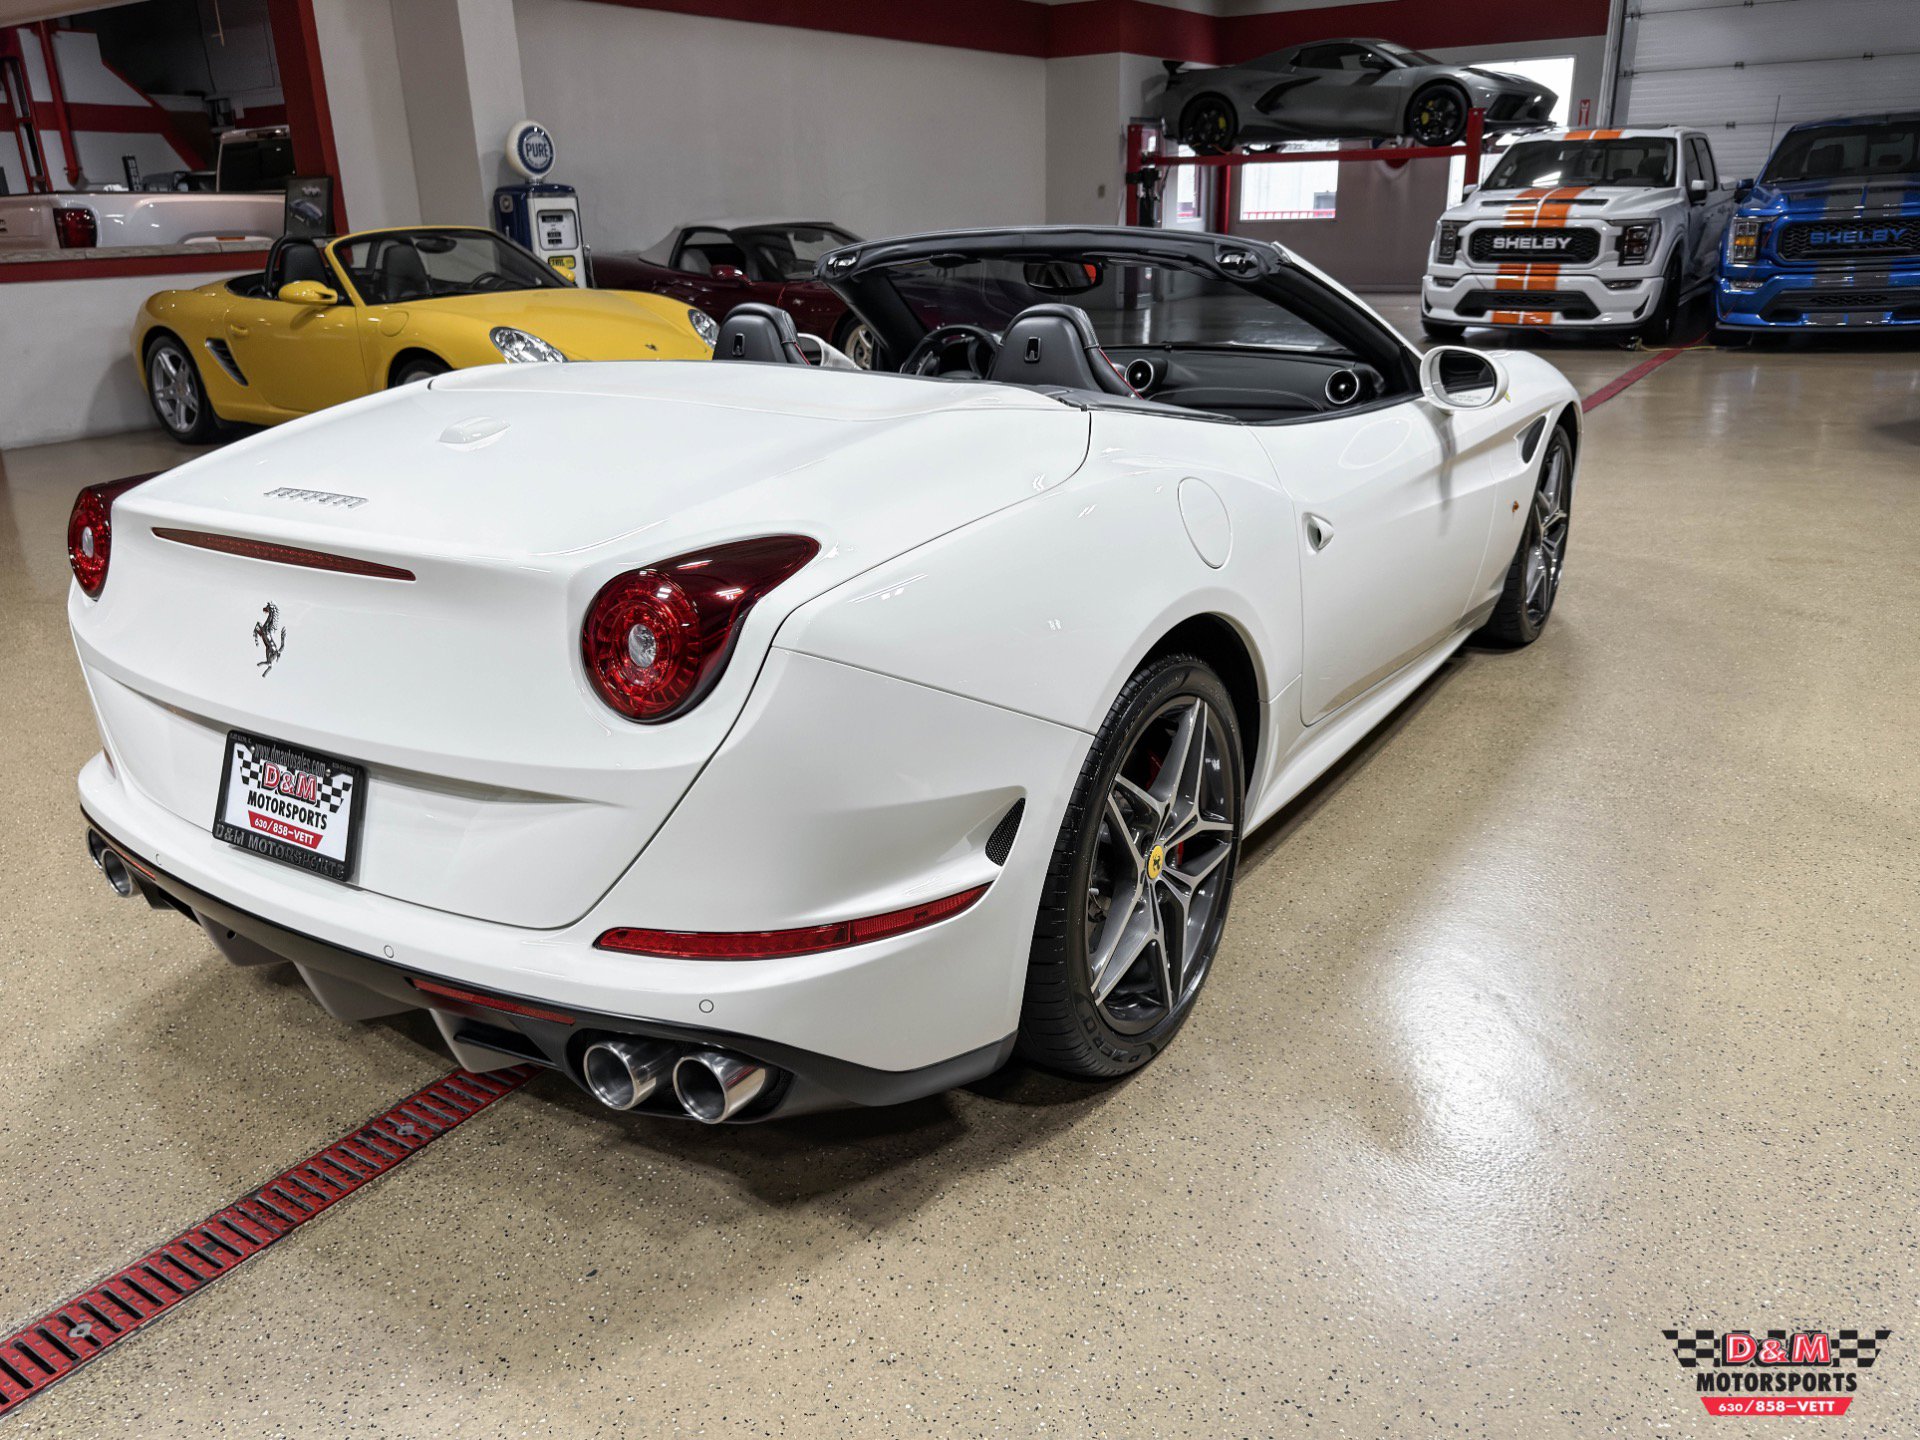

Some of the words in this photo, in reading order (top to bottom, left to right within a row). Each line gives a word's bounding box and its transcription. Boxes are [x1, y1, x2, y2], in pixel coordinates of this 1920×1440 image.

[526, 143, 549, 157] PURE
[1493, 237, 1572, 249] SHELBY
[1810, 228, 1907, 244] SHELBY
[263, 761, 319, 803] D&M
[247, 791, 328, 830] MOTORSPORTS
[216, 824, 245, 846] D&M
